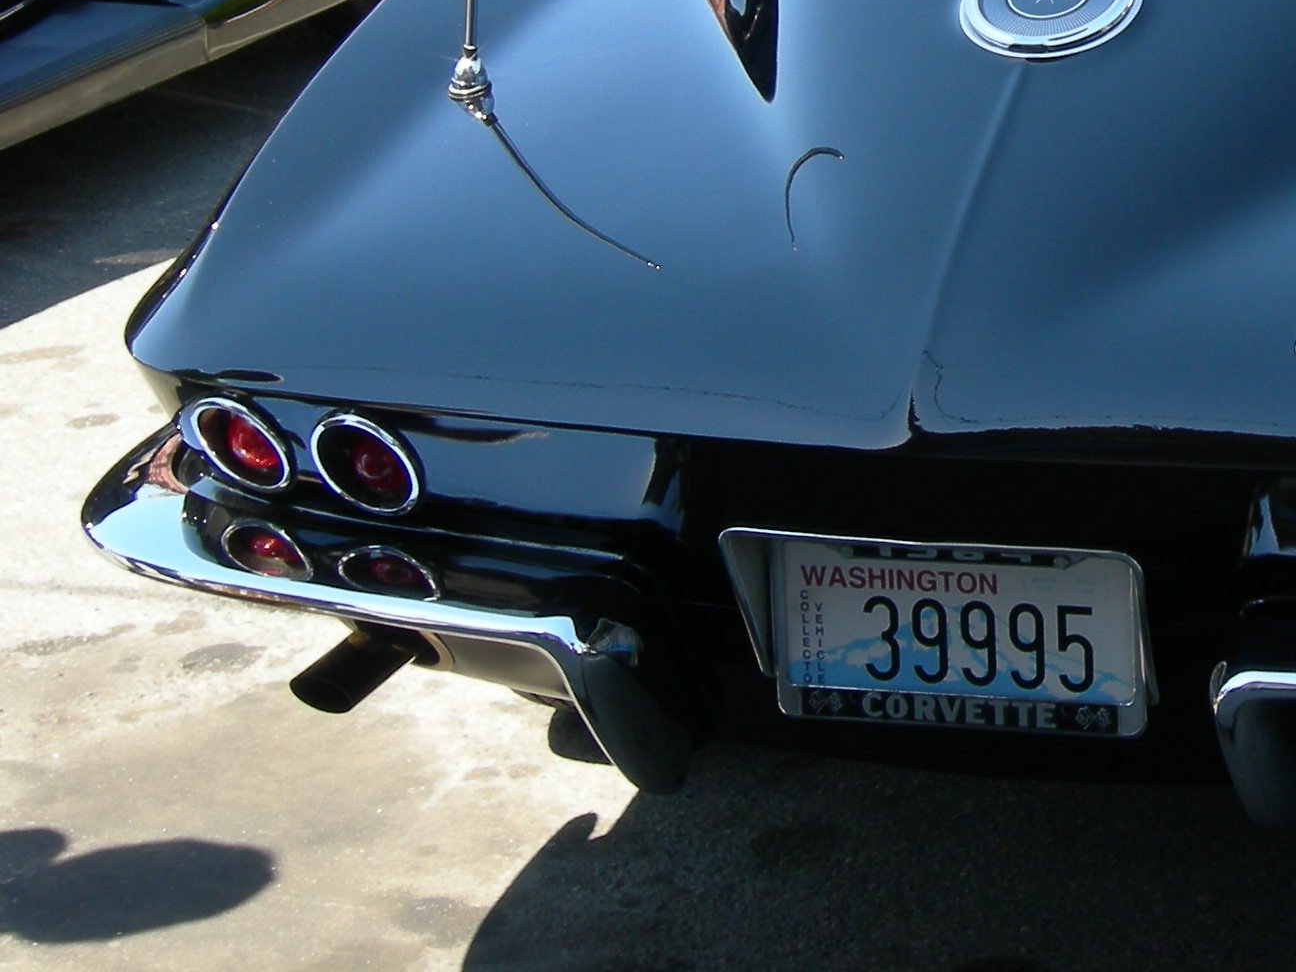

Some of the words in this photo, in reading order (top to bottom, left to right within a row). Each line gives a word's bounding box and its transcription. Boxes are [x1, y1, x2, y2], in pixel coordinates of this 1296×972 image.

[800, 565, 998, 596] WASHINGTON
[799, 588, 814, 685] COLLECTO
[814, 601, 827, 685] VEHICLE
[863, 595, 1095, 694] 39995
[862, 691, 1057, 729] CORVETTE
